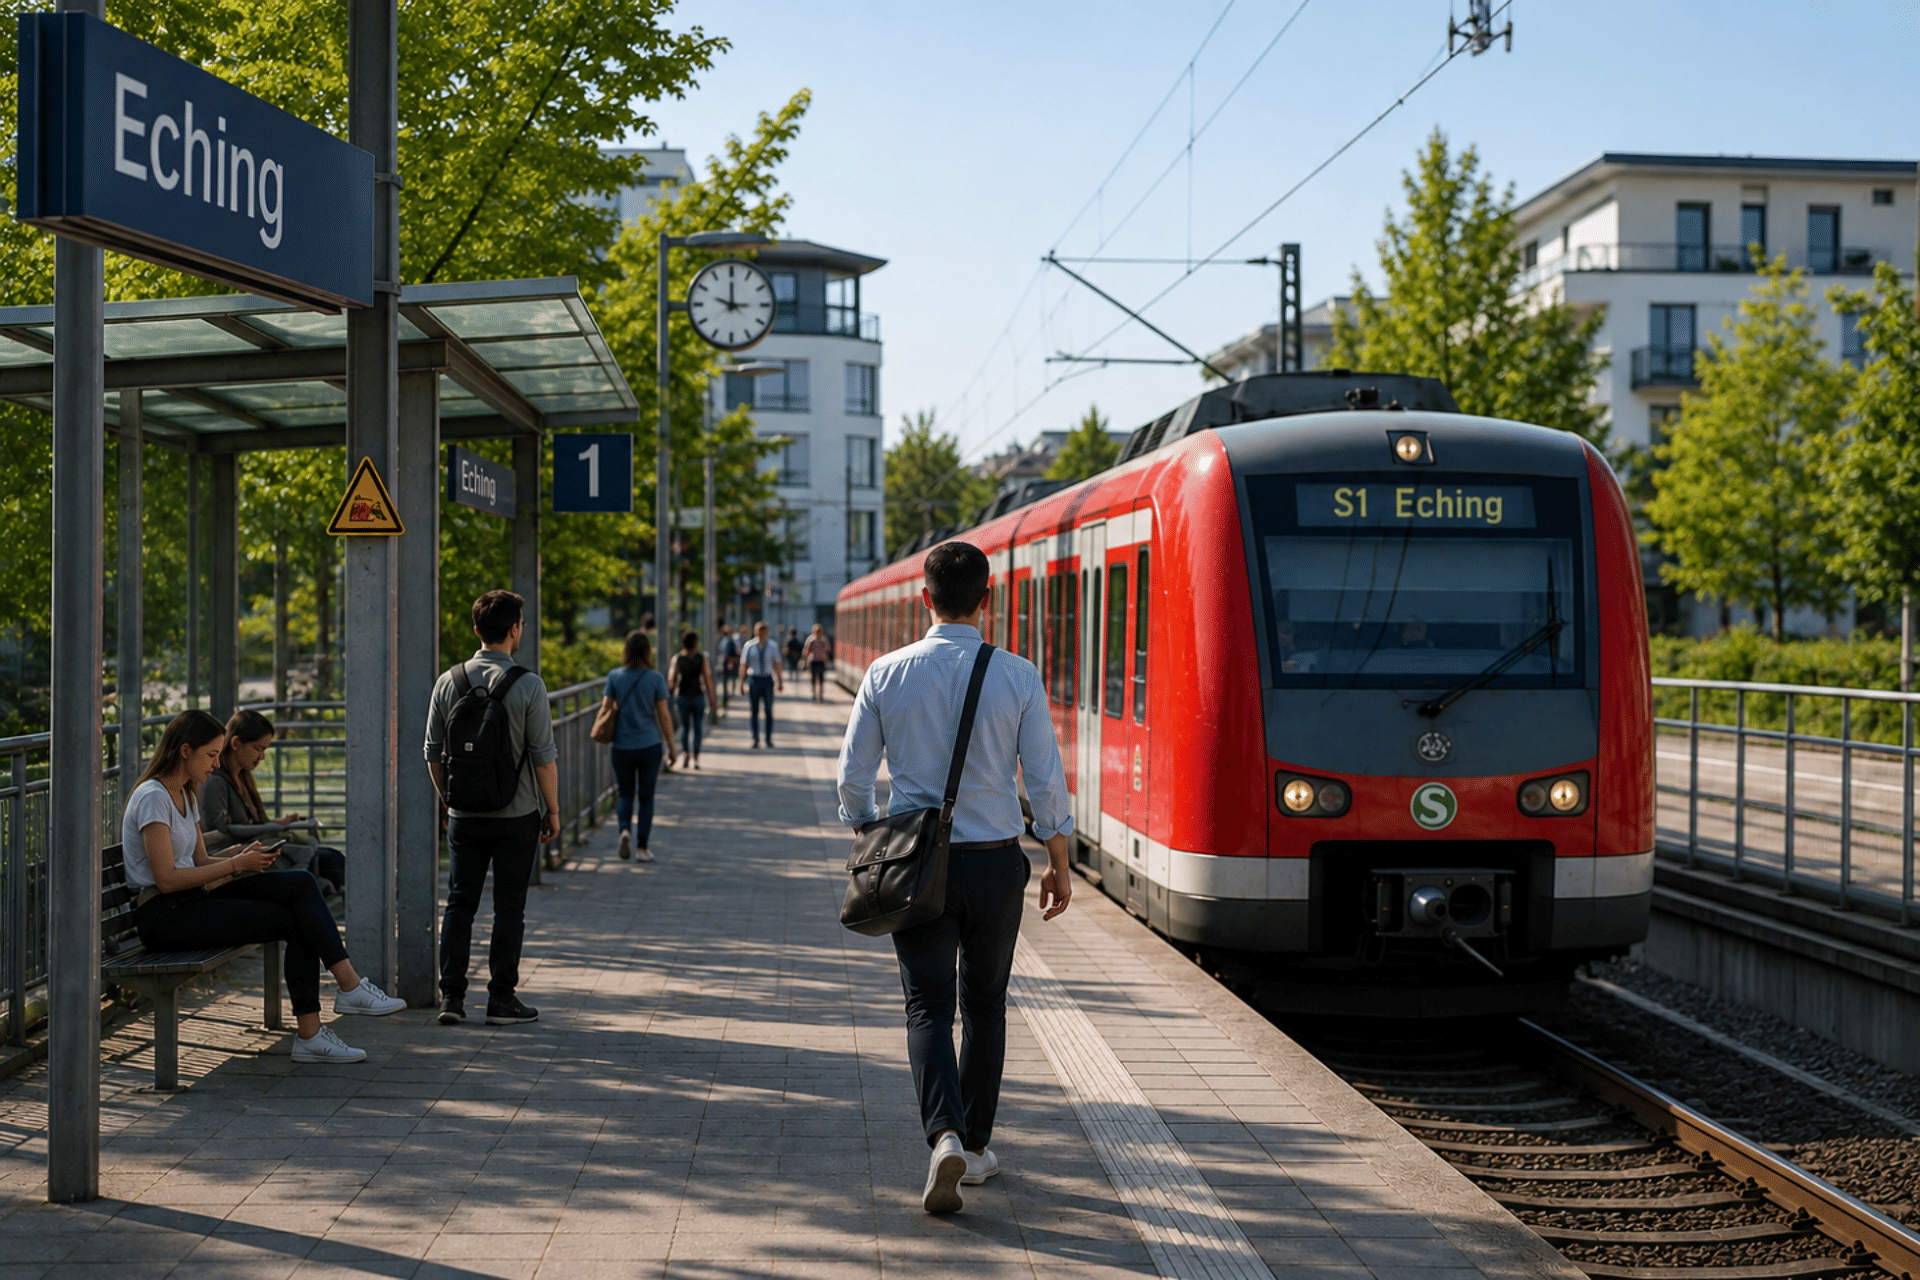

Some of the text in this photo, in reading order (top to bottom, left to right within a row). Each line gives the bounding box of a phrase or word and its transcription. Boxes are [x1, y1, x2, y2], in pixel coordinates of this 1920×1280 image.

[114, 71, 284, 250] Eching
[461, 459, 497, 506] Eching
[578, 443, 600, 498] 1
[1333, 487, 1502, 524] S1 Eching
[1420, 787, 1448, 825] S
